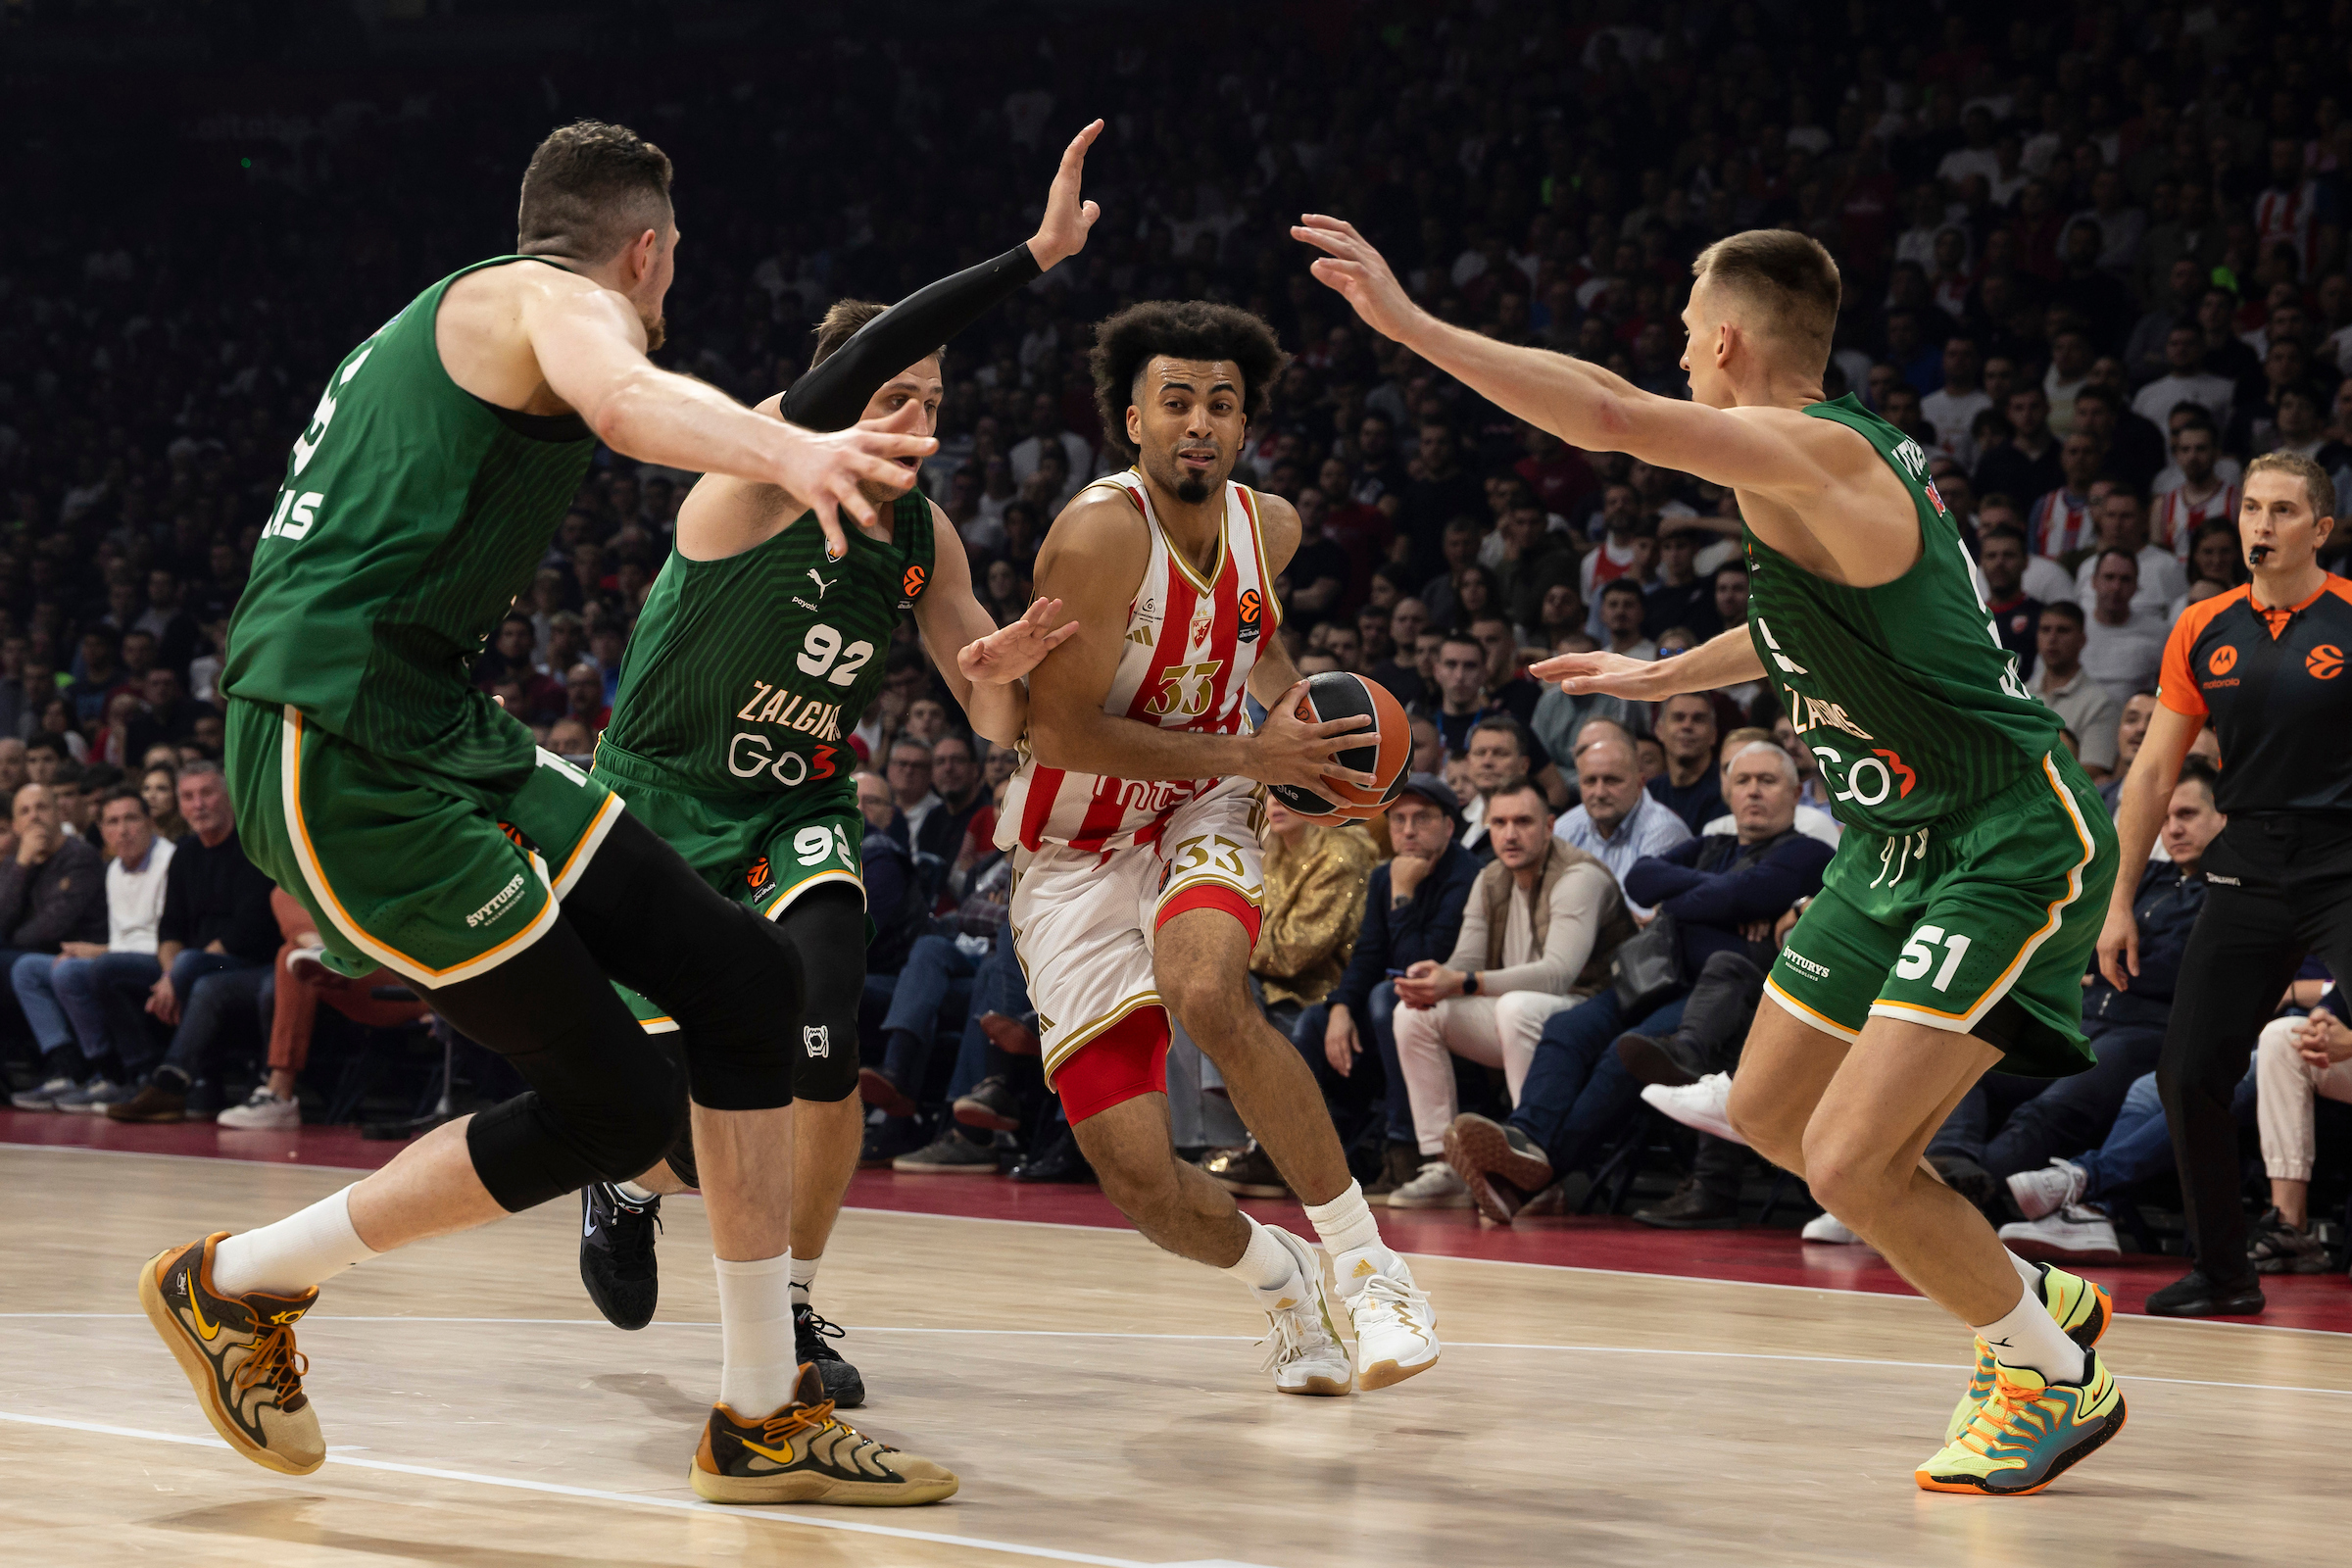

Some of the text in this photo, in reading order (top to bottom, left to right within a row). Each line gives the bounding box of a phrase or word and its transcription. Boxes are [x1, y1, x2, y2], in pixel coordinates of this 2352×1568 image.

[796, 623, 874, 686] 92
[1144, 661, 1224, 716] 33
[2203, 677, 2240, 689] motorola
[793, 823, 856, 873] 92
[1175, 834, 1245, 877] 33
[466, 873, 525, 928] ŠVYTURYS
[1783, 945, 1831, 978] ŠVYTURYS
[1895, 924, 1972, 993] 51
